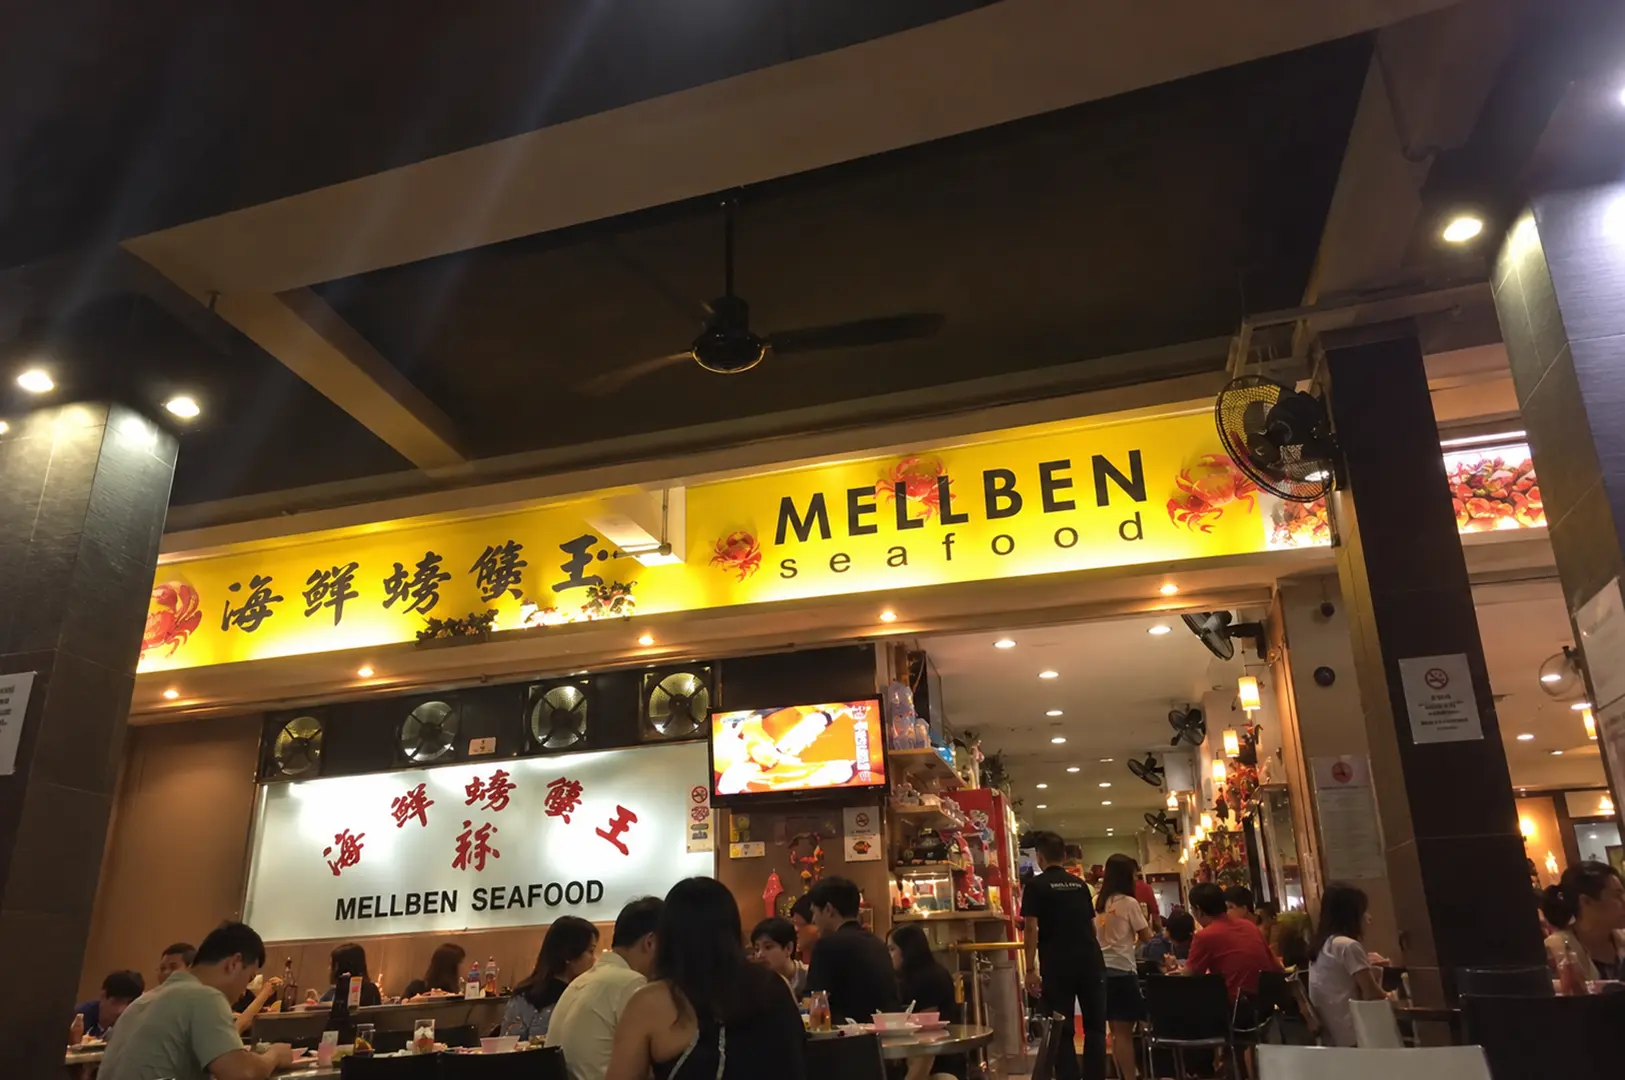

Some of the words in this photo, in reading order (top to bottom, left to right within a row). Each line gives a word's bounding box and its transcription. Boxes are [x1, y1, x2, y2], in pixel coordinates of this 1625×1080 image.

[775, 450, 1147, 546] MELLBEN
[781, 511, 1143, 578] seafood
[335, 889, 458, 921] MELLBEN
[472, 879, 604, 912] SEAFOOD
